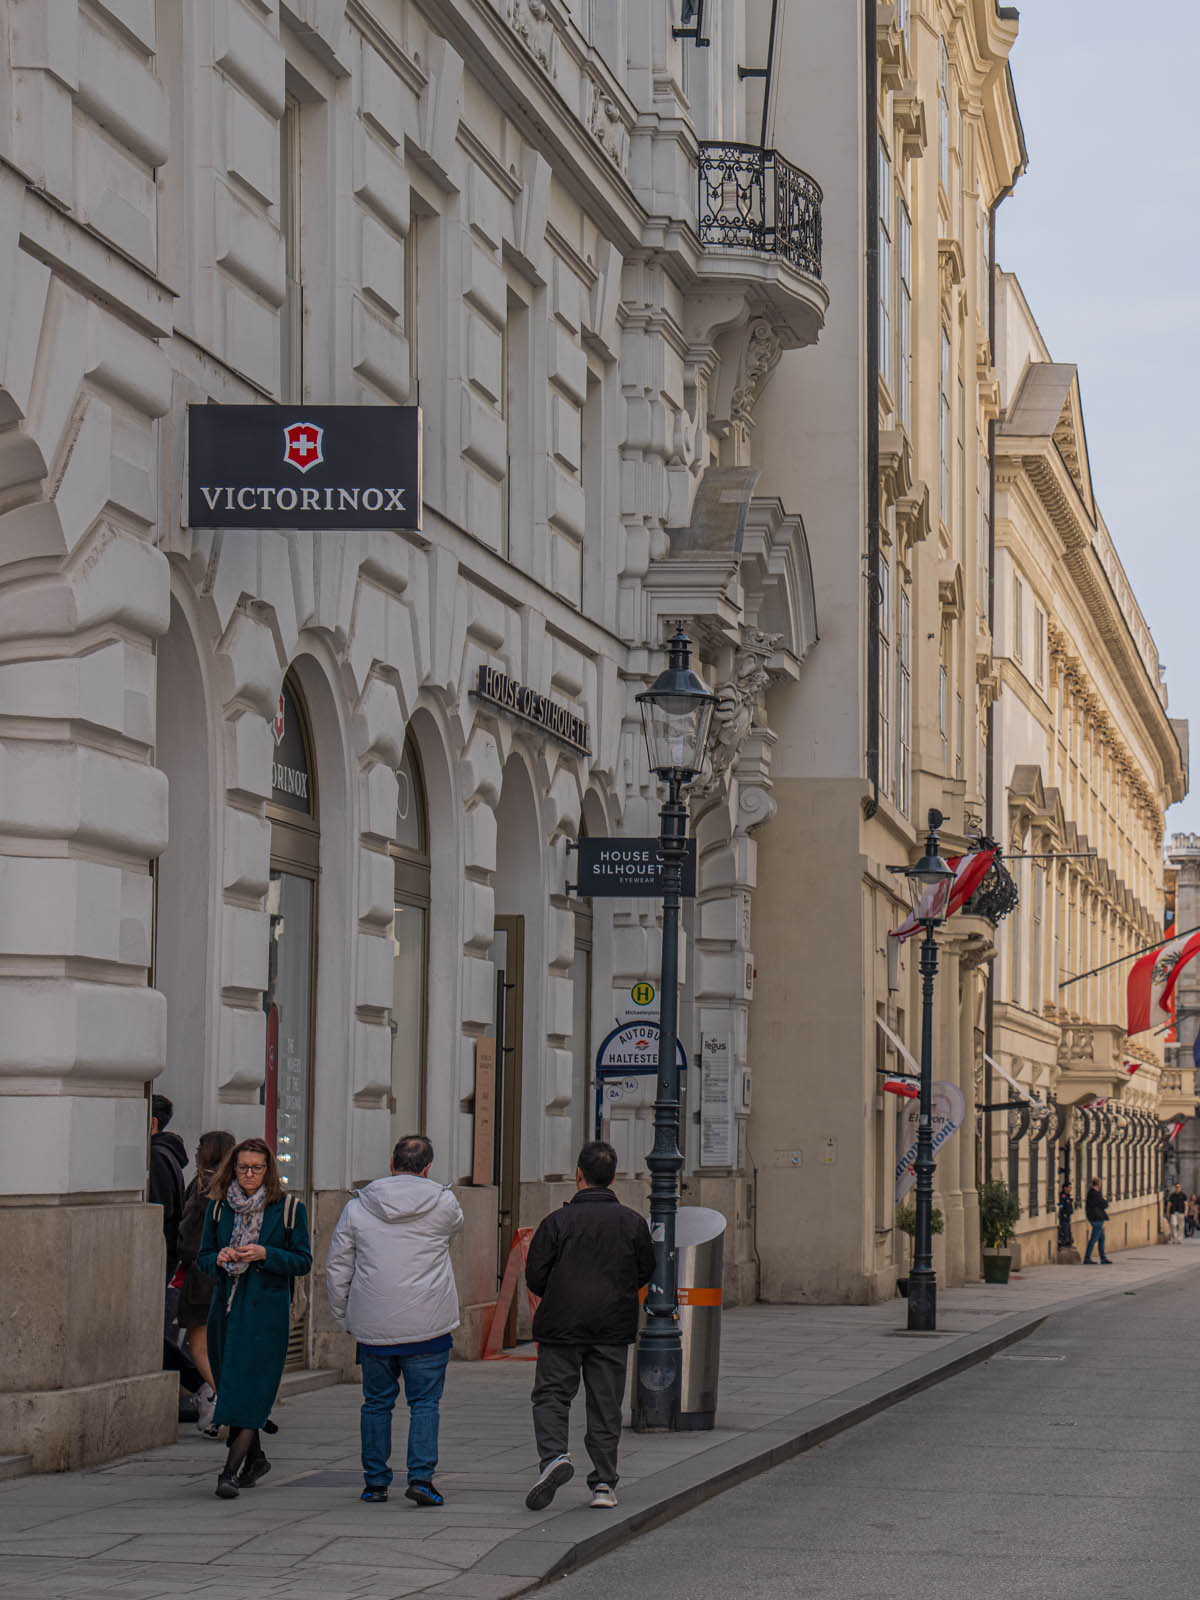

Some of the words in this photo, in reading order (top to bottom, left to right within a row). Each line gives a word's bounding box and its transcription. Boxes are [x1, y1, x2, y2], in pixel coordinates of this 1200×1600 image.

[200, 487, 407, 511] VICTORINOX
[485, 668, 520, 710] HOUSE
[523, 687, 538, 716] OF
[272, 762, 308, 798] ORINOX
[600, 851, 649, 861] HOUSE
[593, 864, 664, 875] SILHOUET
[620, 1028, 660, 1045] AUTOBU
[609, 1053, 659, 1063] HALTESTE
